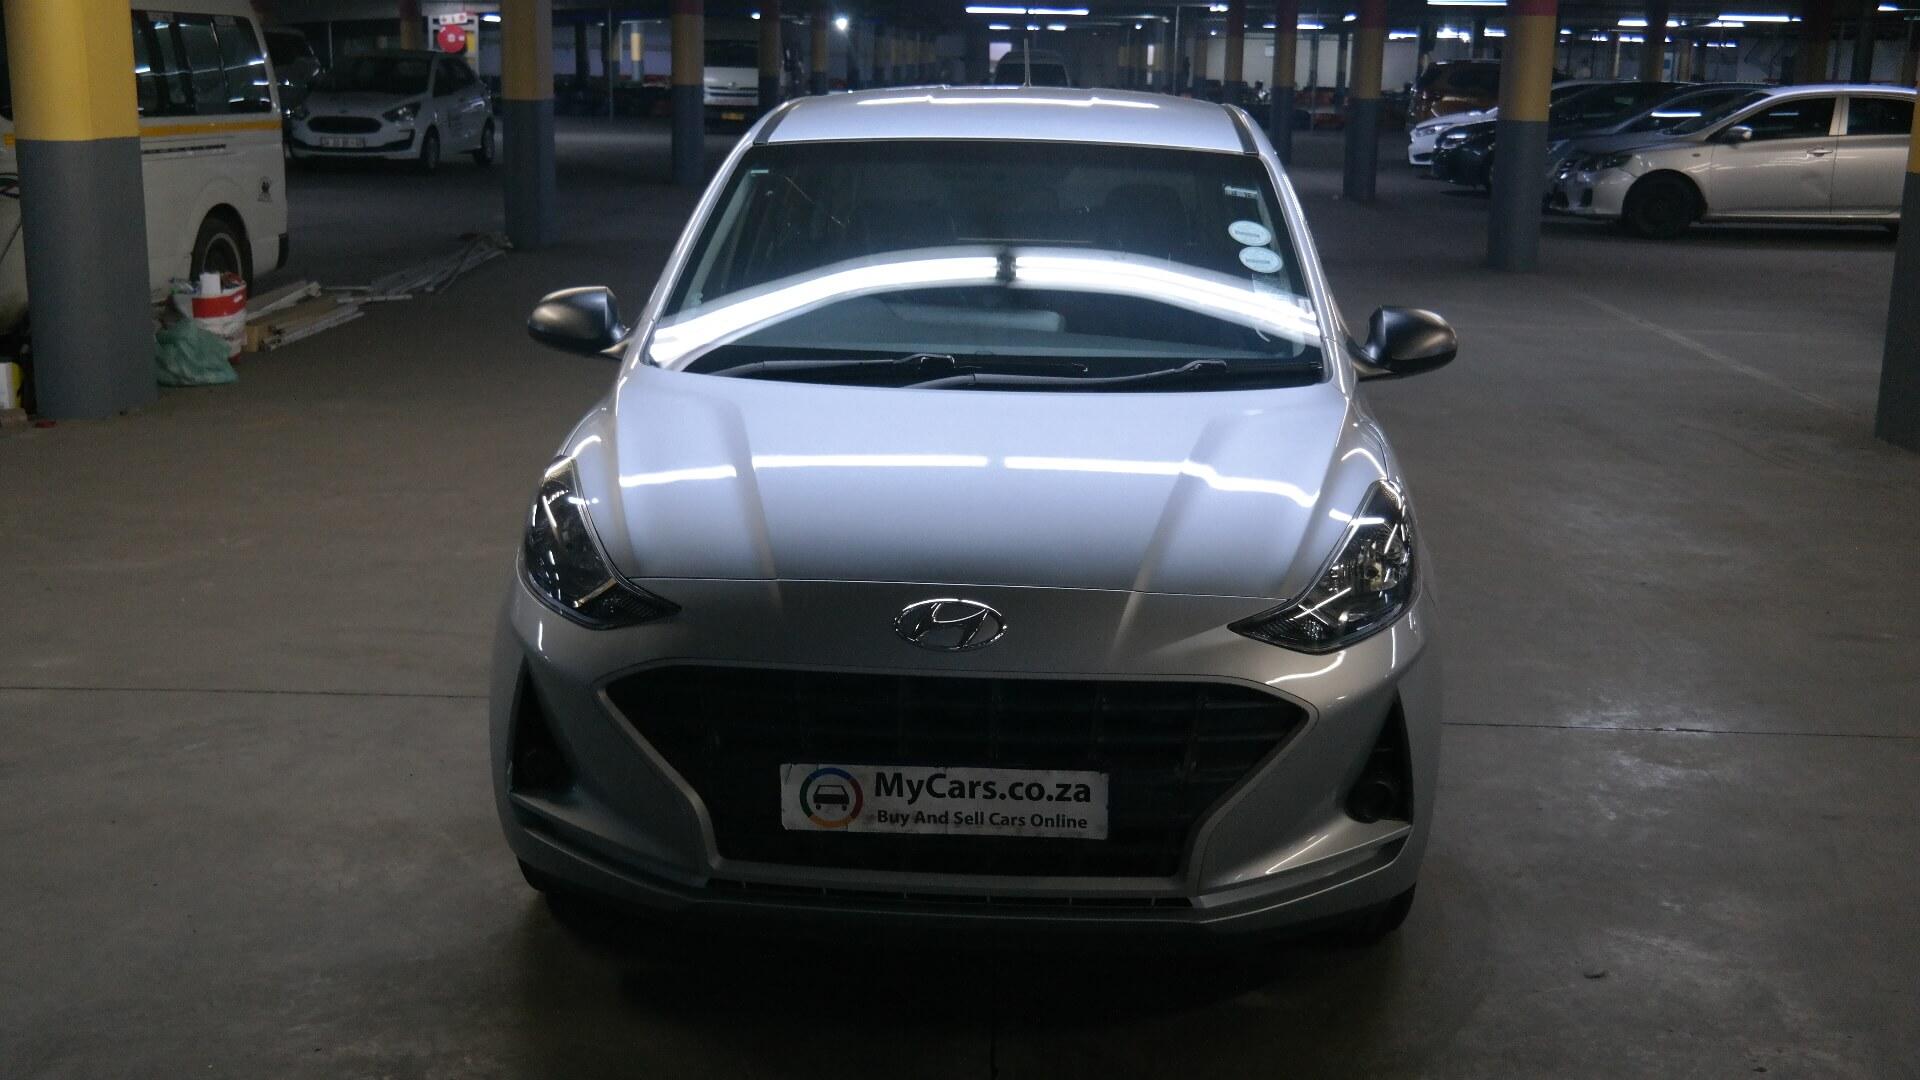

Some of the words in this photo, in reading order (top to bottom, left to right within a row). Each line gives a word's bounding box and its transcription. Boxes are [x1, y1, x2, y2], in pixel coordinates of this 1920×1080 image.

[875, 772, 1091, 804] MyCars.co.za
[877, 810, 909, 826] Buy
[915, 811, 949, 825] And
[953, 811, 984, 826] Sell
[989, 813, 1026, 827] Cars
[1030, 813, 1088, 829] Online
